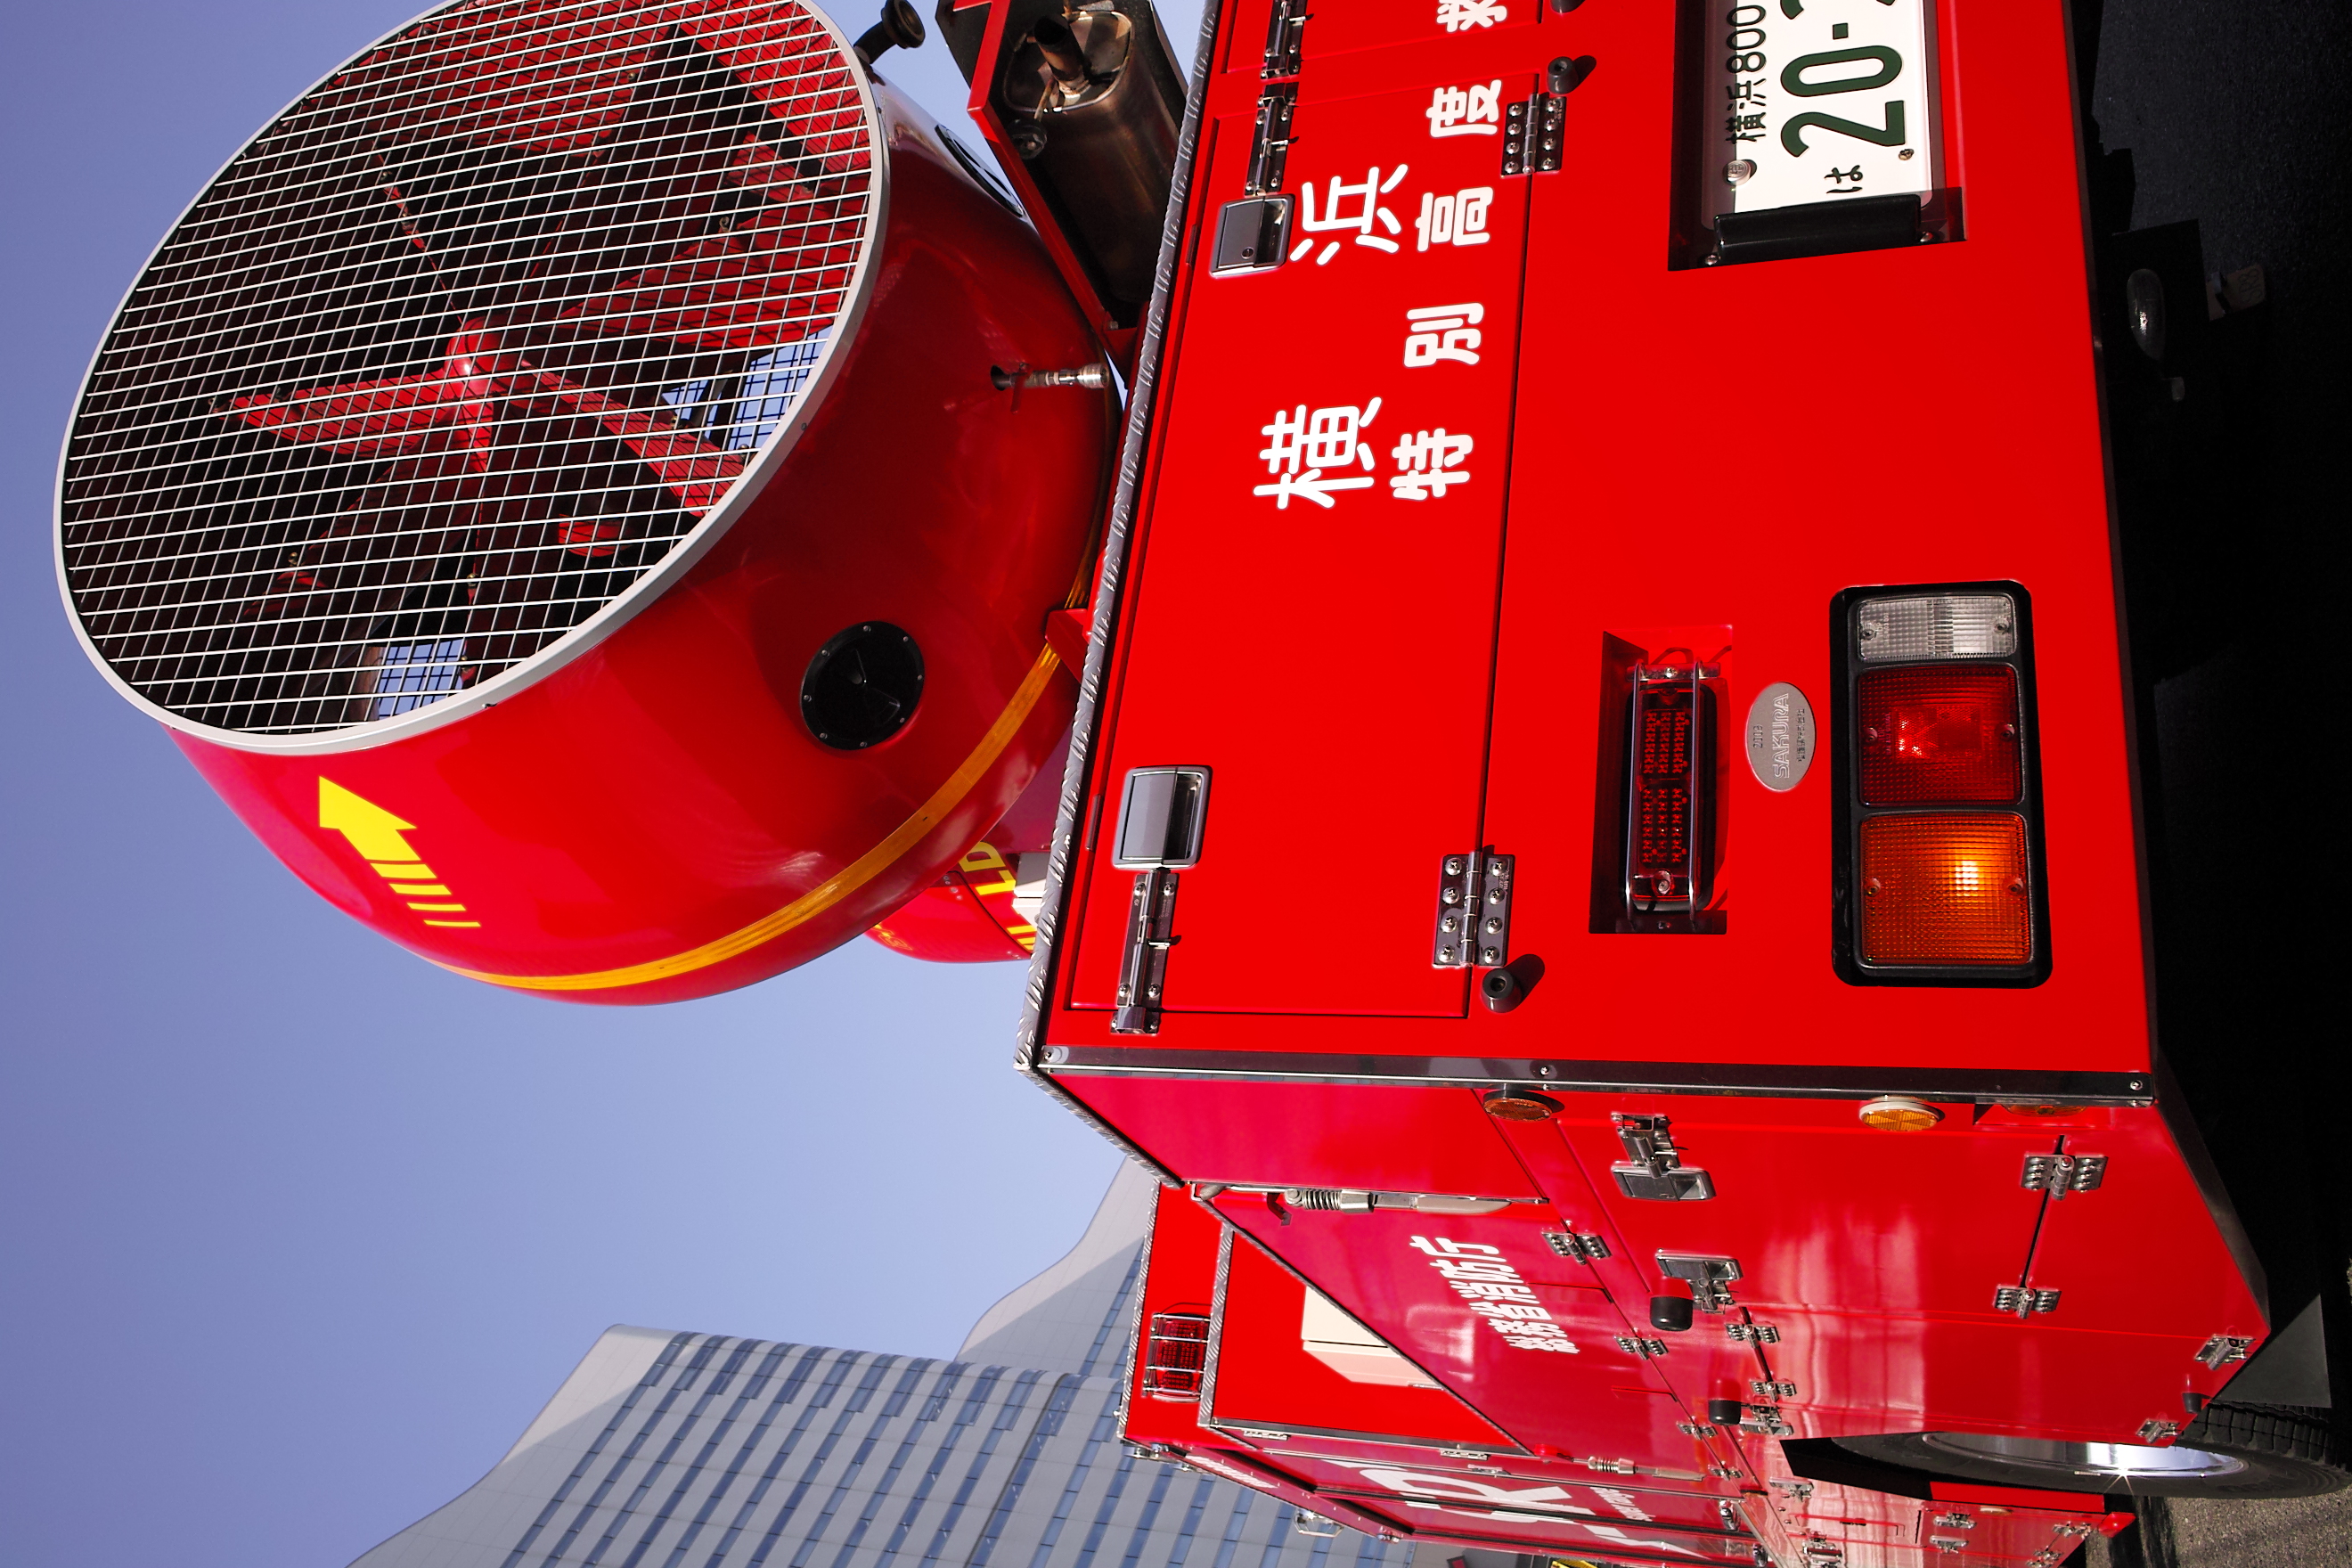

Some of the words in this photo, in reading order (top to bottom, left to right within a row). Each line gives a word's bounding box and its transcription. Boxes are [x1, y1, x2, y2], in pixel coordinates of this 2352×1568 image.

[1780, 0, 1906, 158] 20-
[1824, 164, 1864, 193] は
[1771, 692, 1790, 778] SAKURA
[1409, 1233, 1580, 1354] 総務省消防庁
